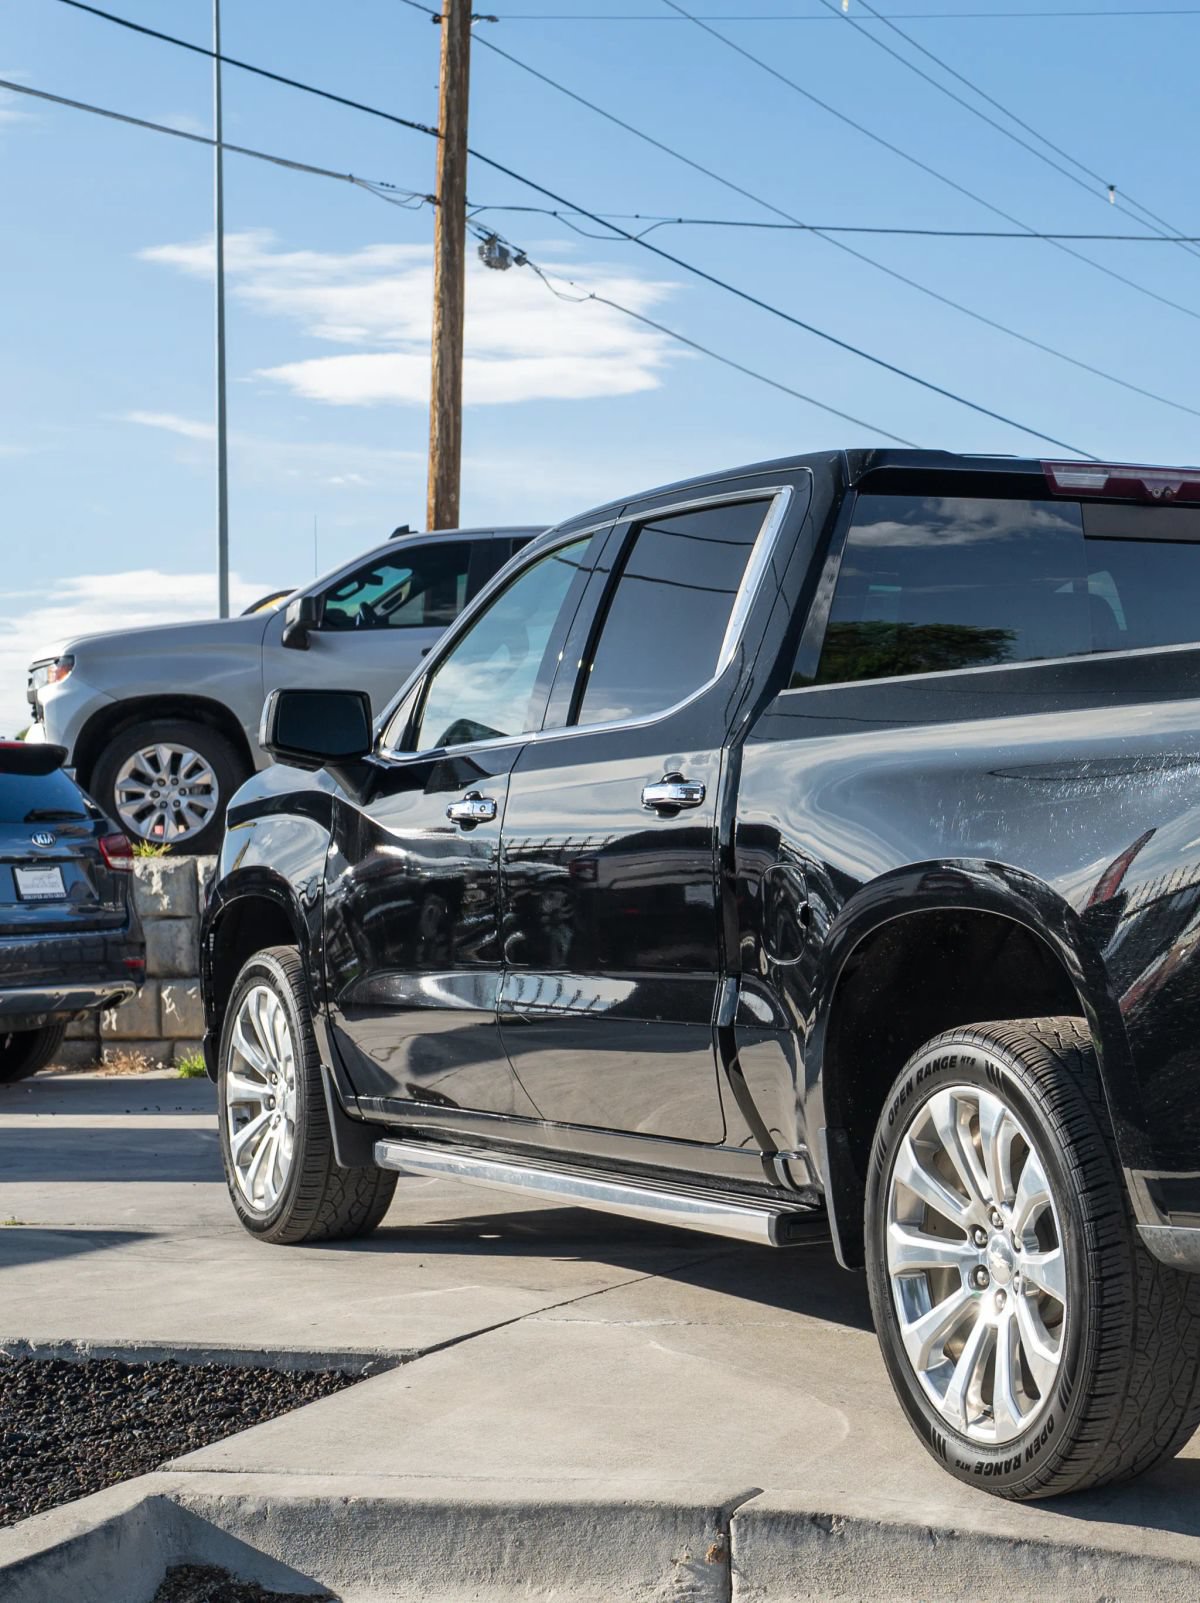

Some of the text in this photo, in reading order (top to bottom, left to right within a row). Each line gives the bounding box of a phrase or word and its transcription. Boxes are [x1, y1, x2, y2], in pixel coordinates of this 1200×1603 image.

[35, 834, 54, 845] KIA
[887, 1078, 914, 1126] OPEN
[916, 1055, 958, 1086] RANGE
[1025, 1413, 1055, 1463] OPEN
[974, 1458, 1022, 1477] RANGE
